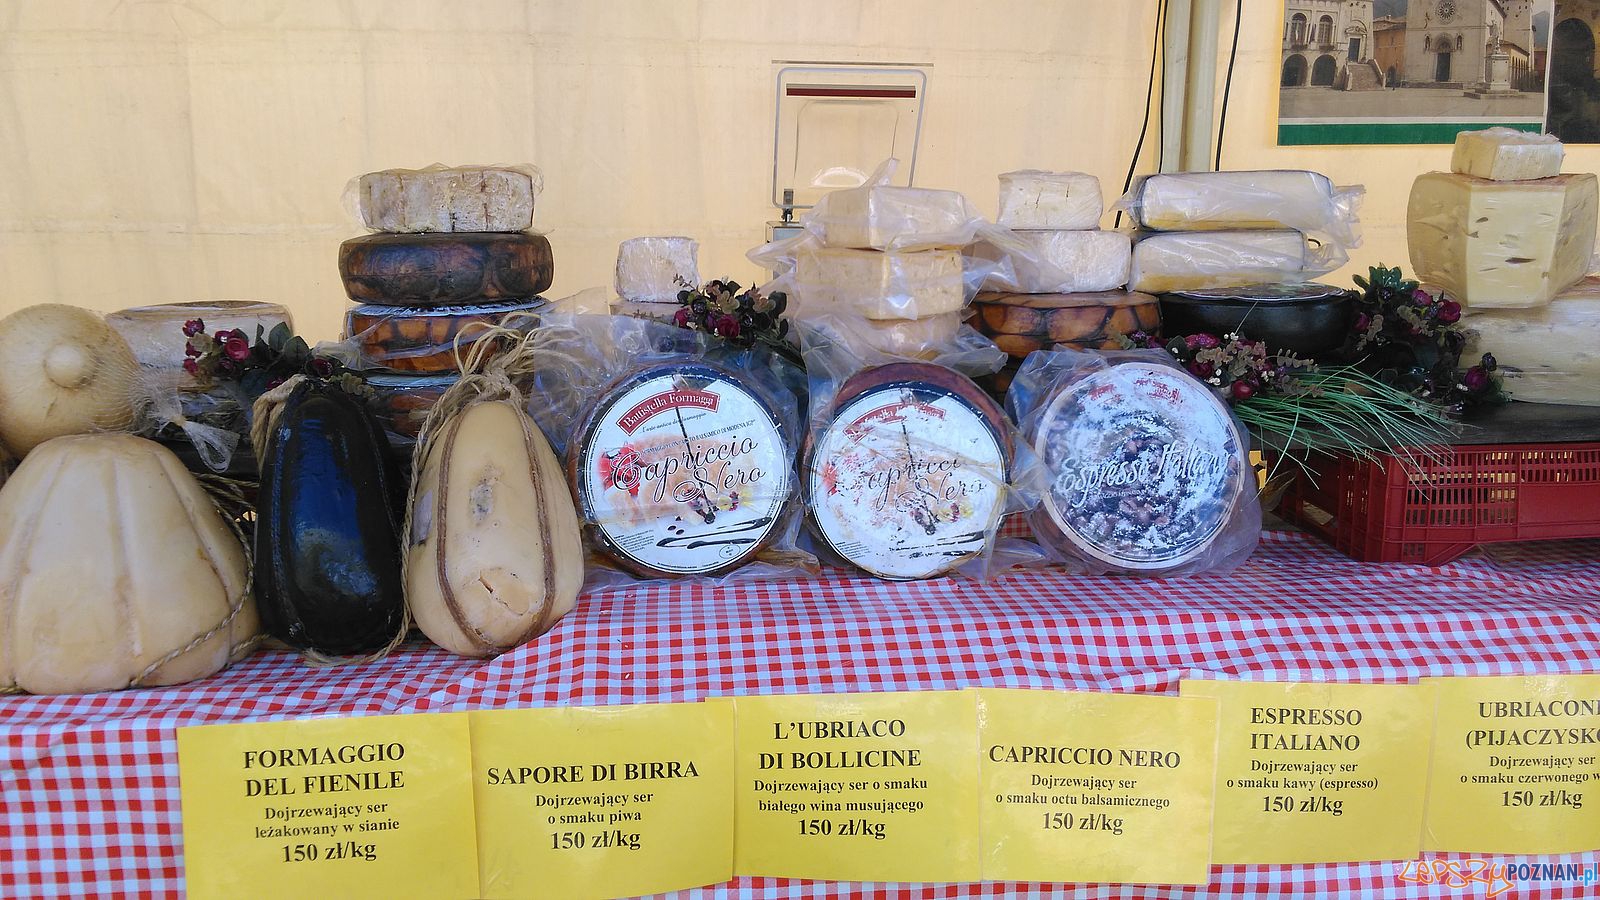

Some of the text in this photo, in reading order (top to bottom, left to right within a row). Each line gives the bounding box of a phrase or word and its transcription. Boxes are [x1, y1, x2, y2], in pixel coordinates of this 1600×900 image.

[622, 393, 715, 428] Battistella Formaggi
[610, 435, 759, 503] Capriccio
[673, 461, 767, 503] Nero
[1250, 707, 1363, 726] ESPRESSO
[1249, 733, 1361, 752] ITALIANO
[1465, 727, 1600, 750] (PIJACZYSK
[243, 742, 405, 769] FORMAGGIO
[758, 749, 922, 770] DI BOLLICINE
[989, 744, 1181, 769] CAPRICCIO NERO
[1489, 754, 1597, 770] Dojrzewający ser
[487, 760, 699, 785] SAPORE DI BIRRA
[1251, 759, 1359, 775] Dojrzewający ser
[245, 770, 405, 797] DEL FIENILE
[753, 777, 928, 796] Dojrzewający ser o smaku
[1031, 774, 1137, 791] Dojrzewający ser
[1226, 776, 1379, 792] o smaku kawy (espresso)
[1460, 775, 1468, 784] o
[1471, 772, 1514, 784] smaku
[1518, 773, 1589, 785] czerwonego
[535, 792, 654, 810] Dojrzewający ser
[758, 798, 924, 815] białego wina musującego
[995, 791, 1170, 810] o smaku octu balsamicznego
[1263, 795, 1344, 817] 150 zł/kg
[1501, 789, 1583, 810] 150 zł/kg
[264, 803, 388, 822] Dojrzewający ser
[547, 809, 642, 826] o smaku piwa
[255, 816, 400, 841] leżakowany w sianie
[798, 818, 886, 841] 150 zł/kg
[1043, 812, 1124, 836] 150 zł/kg
[551, 829, 641, 851] 150 zł/kg
[282, 841, 377, 863] 150 zł/kg
